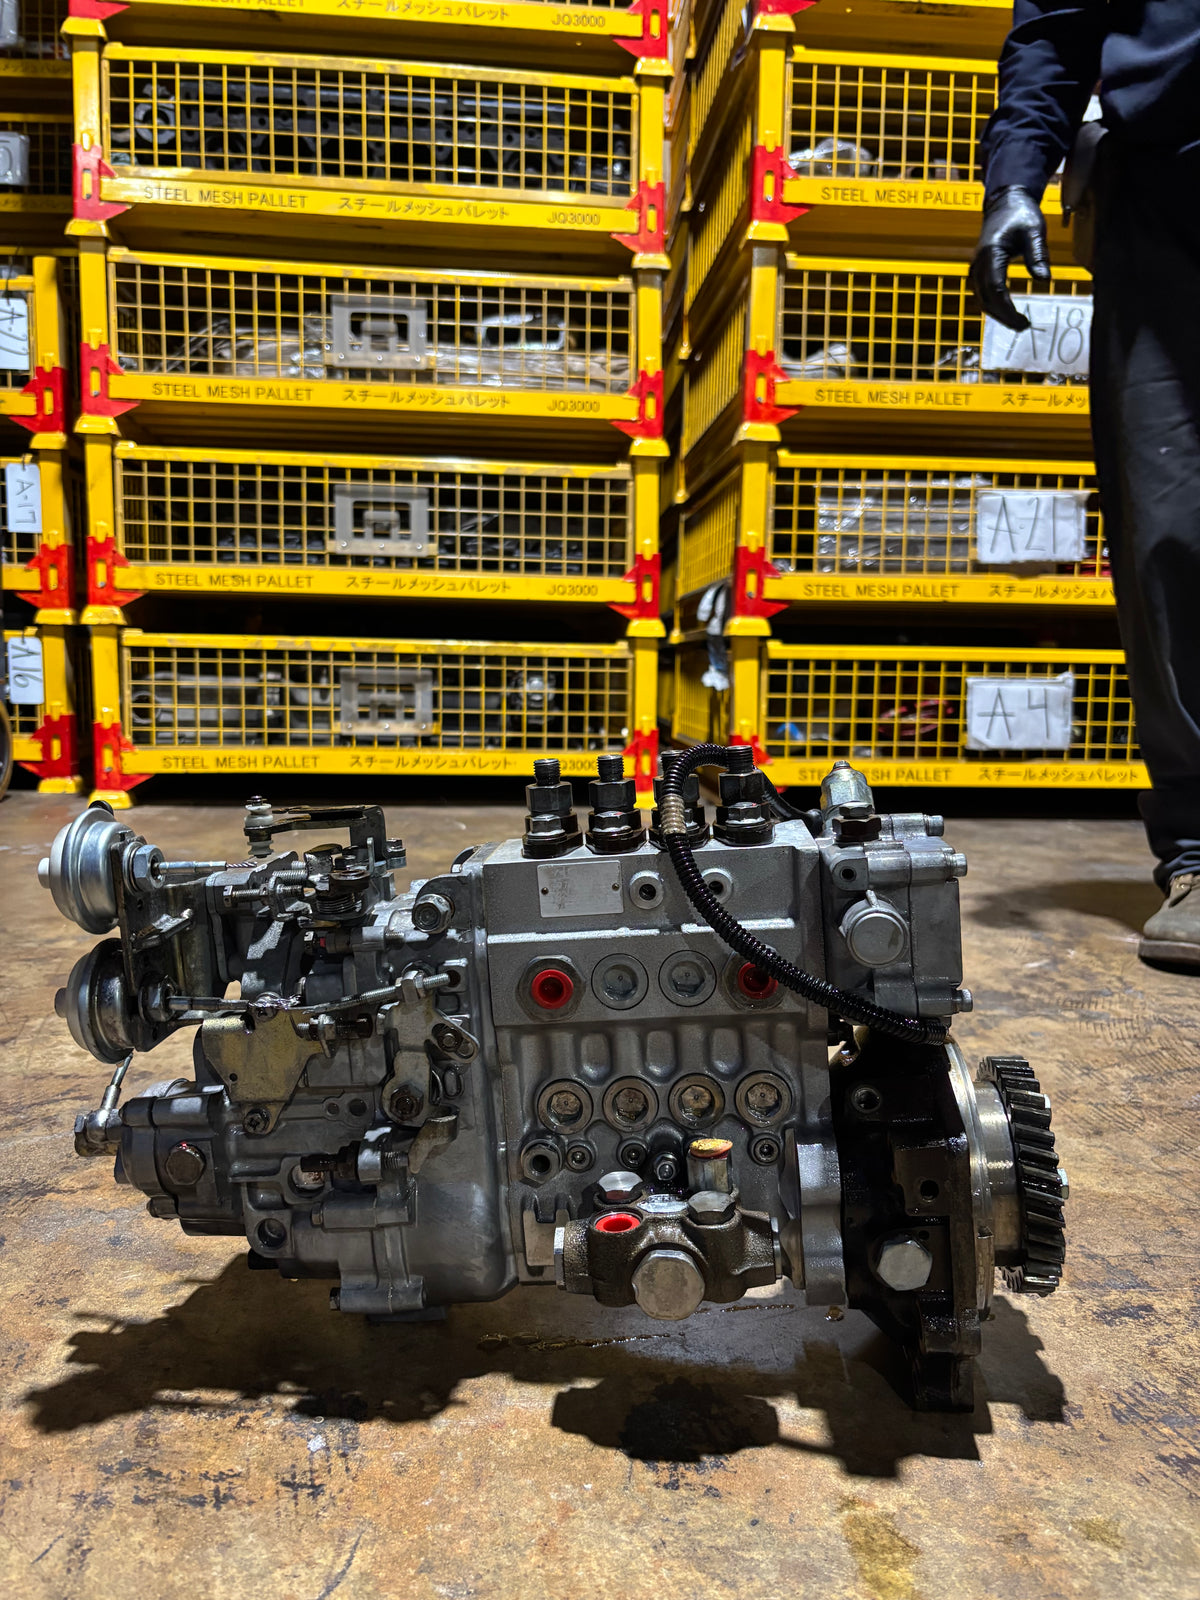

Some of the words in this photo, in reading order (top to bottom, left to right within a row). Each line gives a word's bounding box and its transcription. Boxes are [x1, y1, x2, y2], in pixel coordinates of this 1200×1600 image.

[551, 13, 606, 28] JQ3000
[144, 186, 191, 202] STEEL
[200, 189, 243, 205] MESH
[248, 192, 309, 209] PALLET
[821, 187, 869, 202] STEEL
[875, 189, 918, 204] MESH
[923, 191, 981, 206] PALLET
[547, 210, 600, 226] JQ3000
[152, 382, 200, 397] STEEL
[207, 385, 251, 400] MESH
[255, 387, 313, 402] PALLET
[815, 389, 862, 404] STEEL
[868, 391, 909, 405] MESH
[914, 392, 973, 407] PALLET
[547, 399, 600, 413] JQ3000
[155, 573, 202, 586] STEEL
[209, 574, 251, 588] MESH
[256, 575, 314, 589] PALLET
[546, 584, 598, 596] JQ3000
[803, 583, 850, 598] STEEL
[856, 584, 897, 598] MESH
[902, 585, 960, 598] PALLET
[162, 756, 208, 769] STEEL
[216, 756, 258, 769] MESH
[263, 756, 320, 769] PALLET
[895, 768, 951, 782] PALLET
